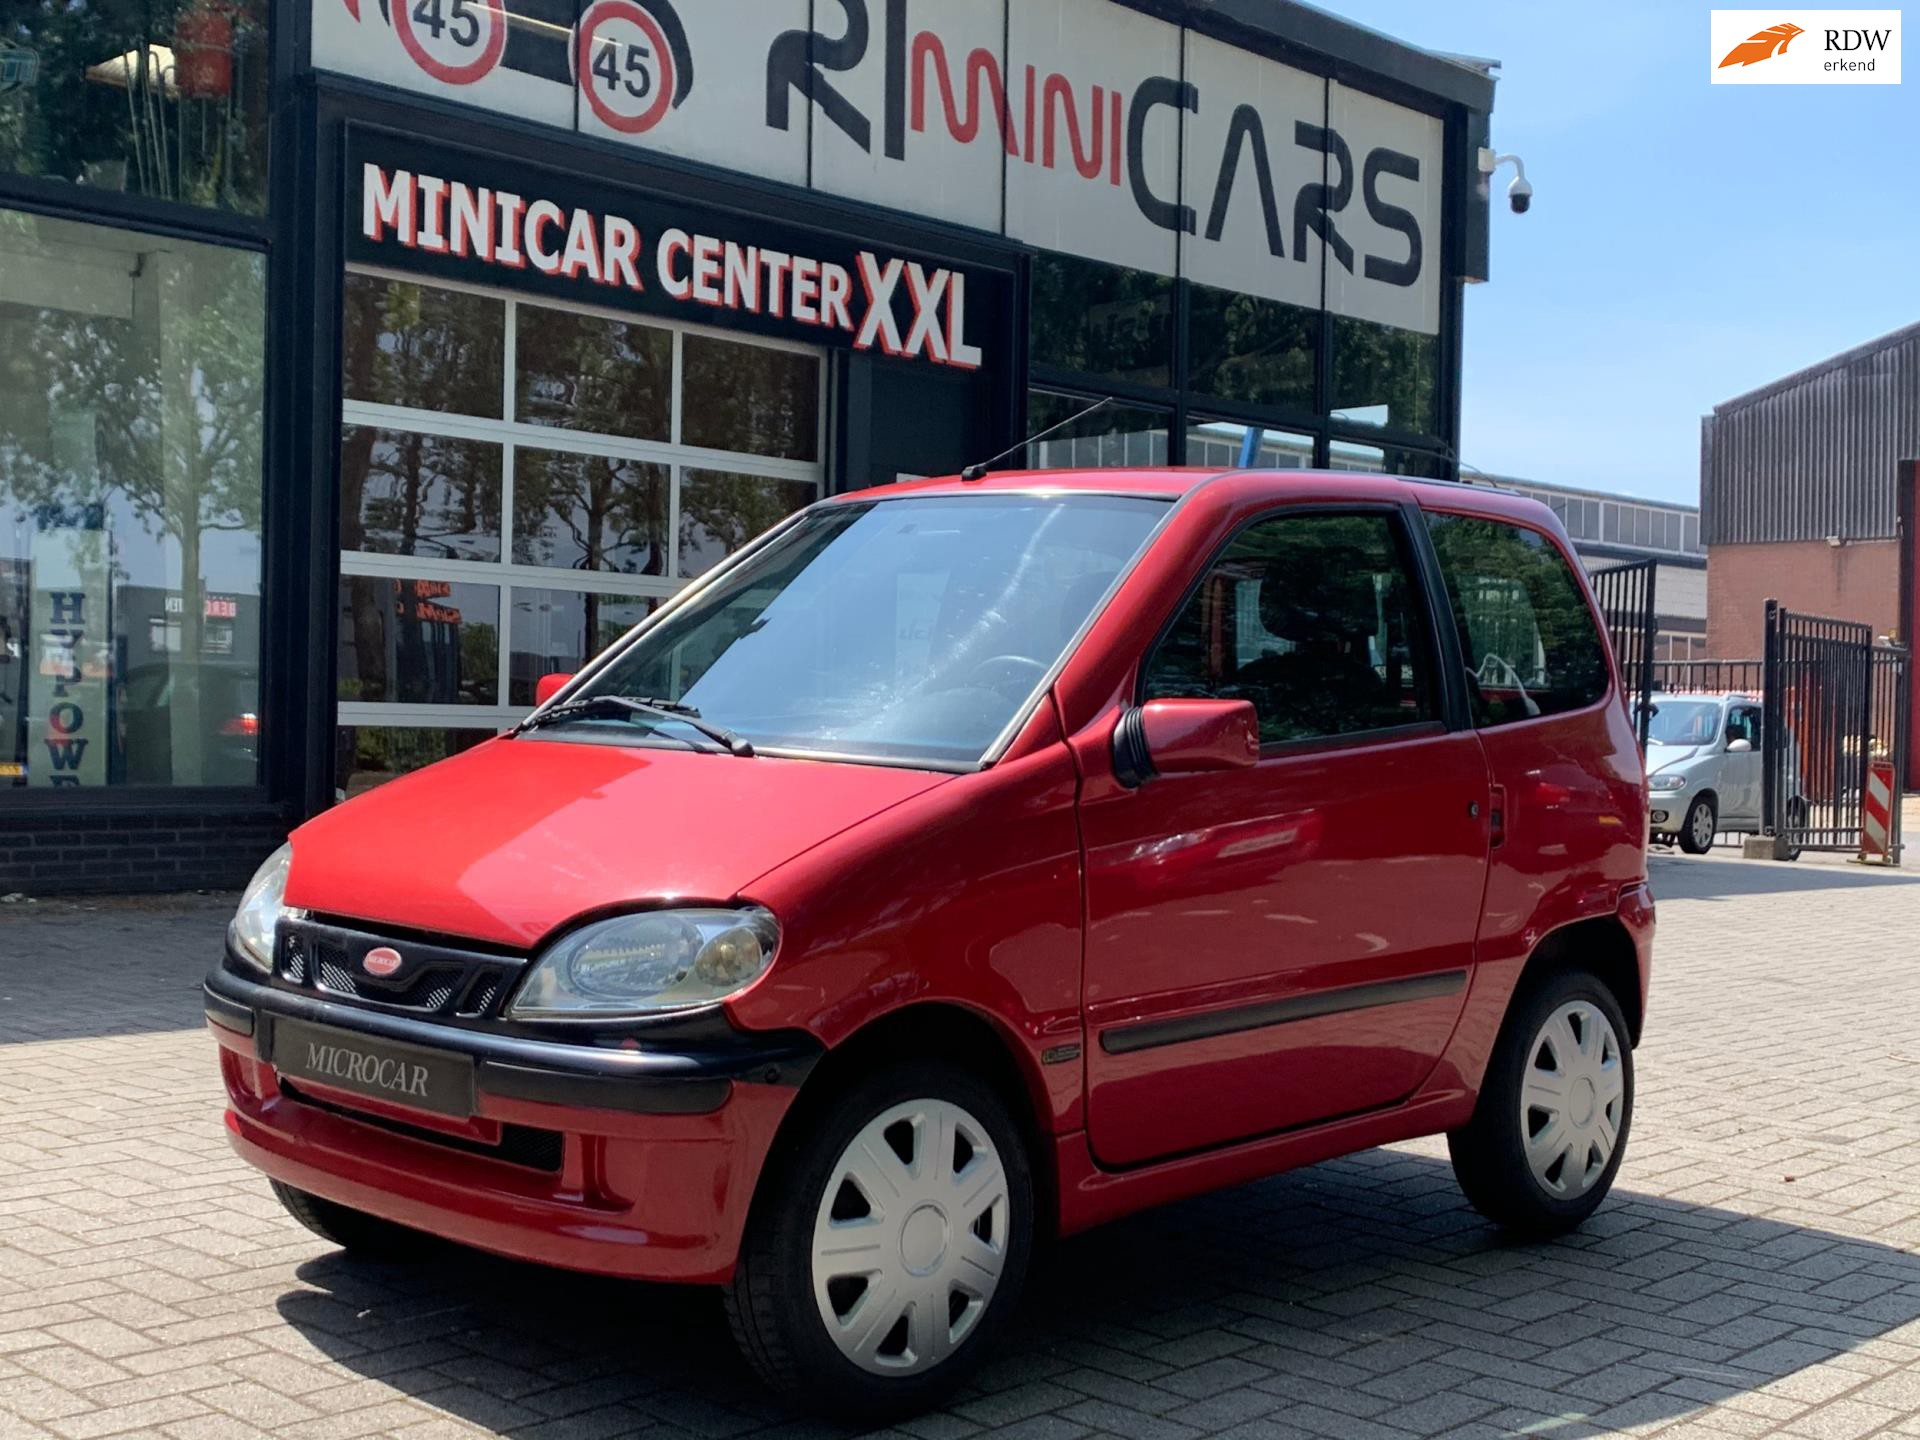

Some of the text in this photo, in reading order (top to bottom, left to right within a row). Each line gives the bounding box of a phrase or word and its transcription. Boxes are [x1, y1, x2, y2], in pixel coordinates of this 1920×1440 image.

[412, 0, 480, 47] 45
[592, 38, 651, 98] 45
[363, 162, 983, 370] MINICAR CENTER XXL
[305, 1042, 429, 1097] MICROCAR
